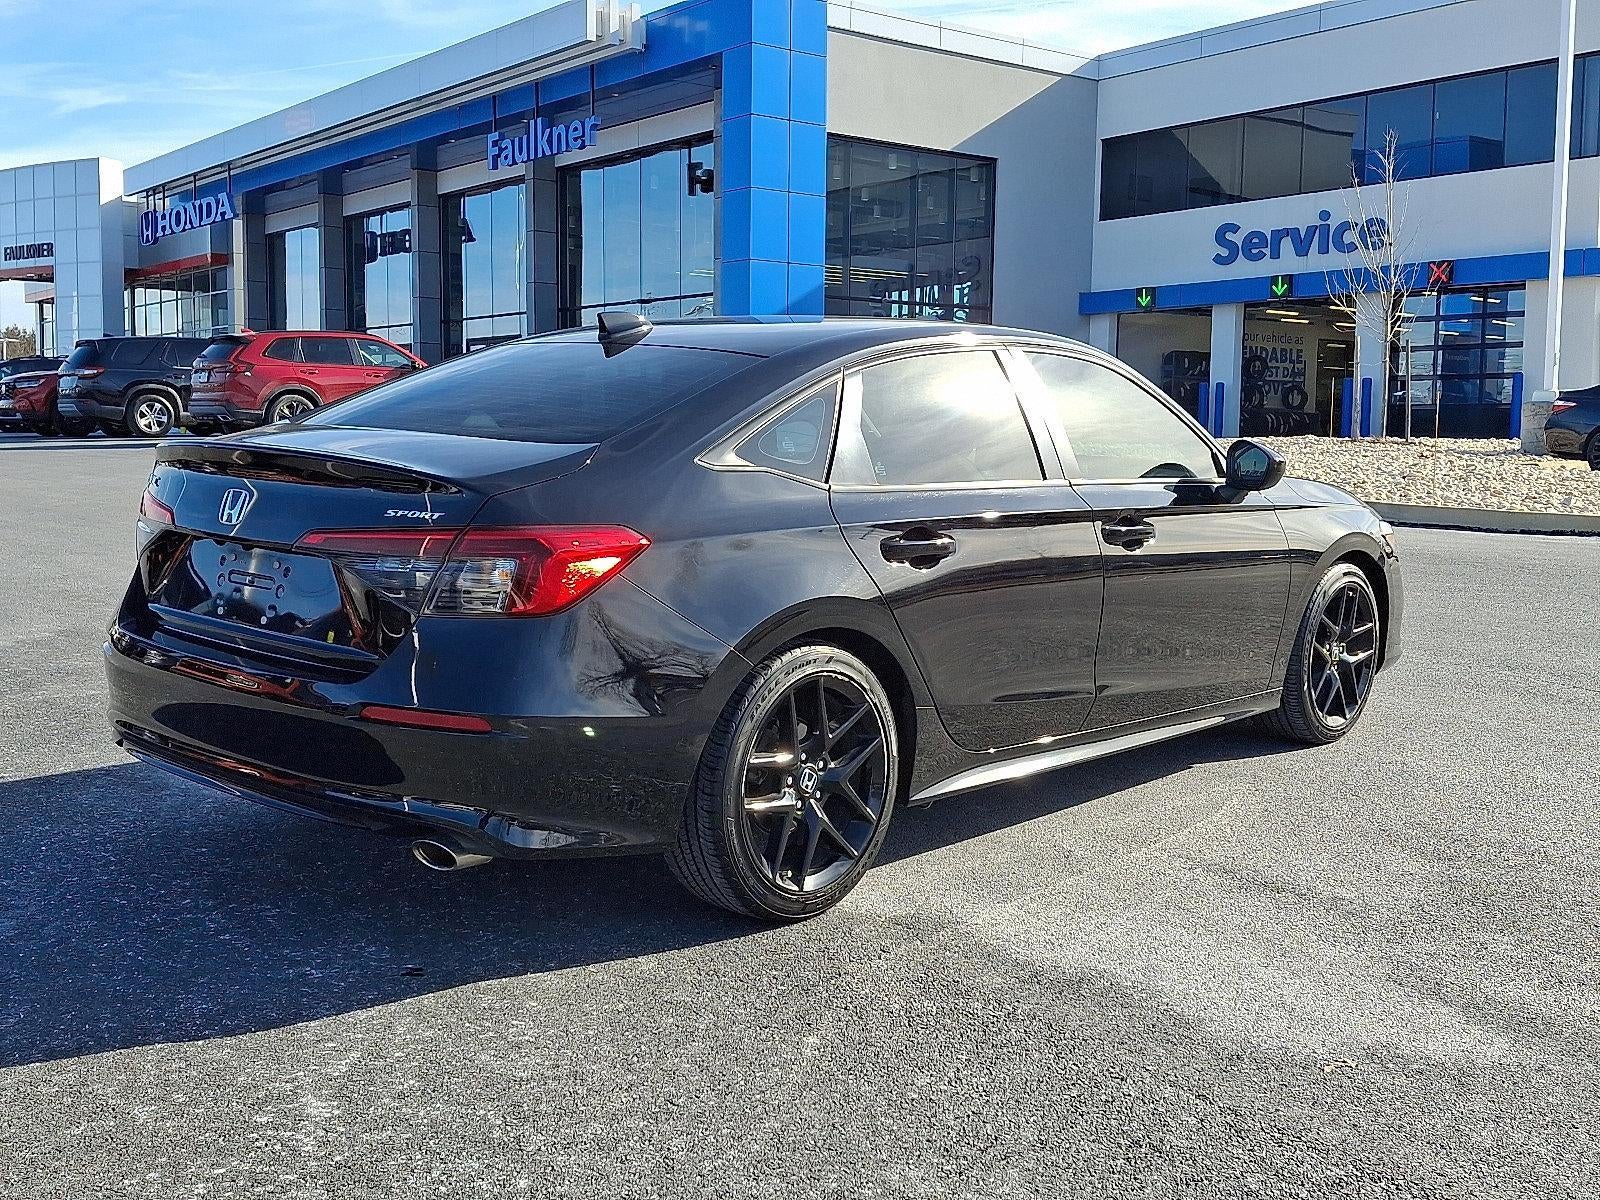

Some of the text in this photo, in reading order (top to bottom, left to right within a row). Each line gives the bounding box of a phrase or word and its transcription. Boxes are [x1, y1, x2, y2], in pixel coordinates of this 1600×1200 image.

[487, 115, 601, 170] Faulkner
[155, 192, 234, 238] HONDA
[1212, 209, 1388, 266] Service
[4, 241, 54, 261] FAULKNER
[1244, 331, 1304, 345] our vehicle as
[1243, 345, 1304, 364] ENDABLE
[384, 509, 446, 520] SPORT
